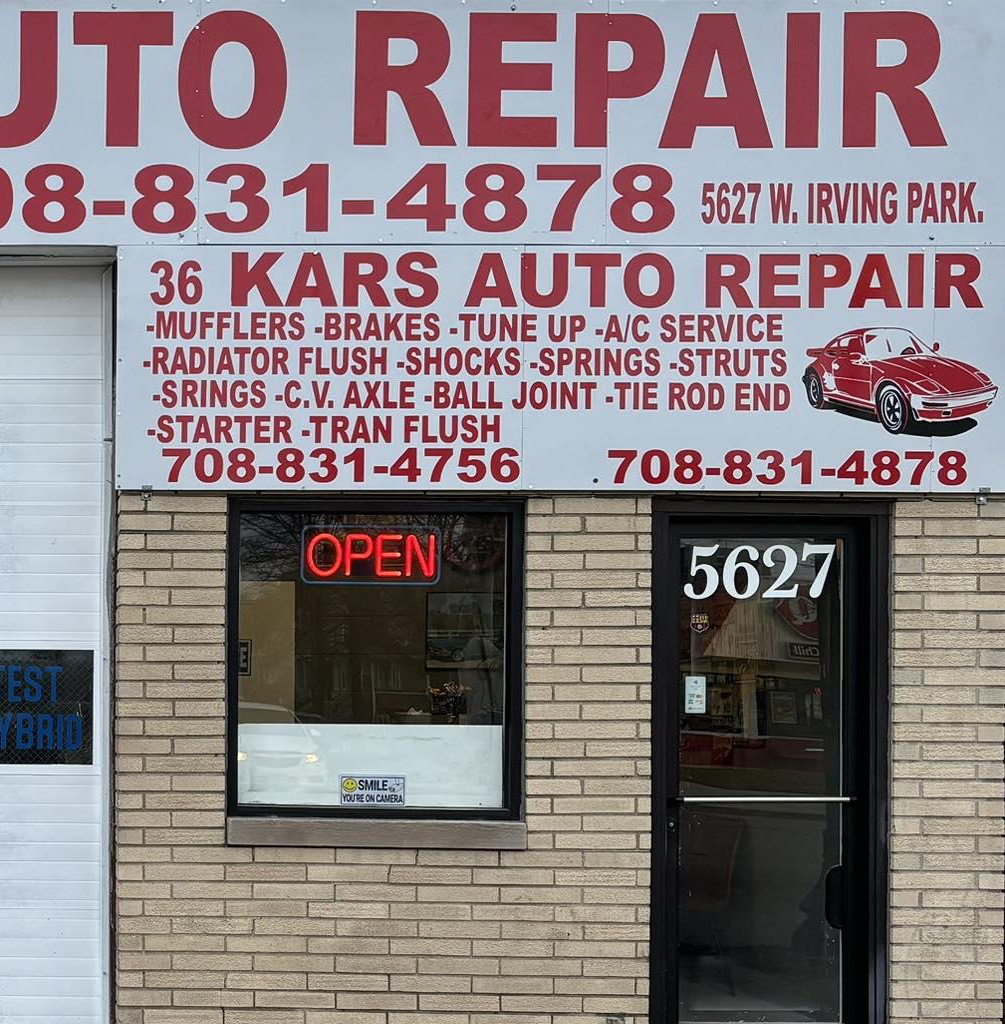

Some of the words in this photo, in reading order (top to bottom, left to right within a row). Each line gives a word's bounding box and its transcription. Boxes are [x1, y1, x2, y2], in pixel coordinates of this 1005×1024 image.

[354, 11, 948, 149] REPAIR
[701, 182, 761, 224] 5627
[770, 183, 798, 224] W.
[808, 182, 898, 224] IRVING
[907, 182, 984, 224] PARK.
[150, 260, 202, 304] 36
[231, 252, 439, 308] KARS
[466, 252, 675, 309] AUTO
[705, 253, 983, 309] REPAIR
[146, 311, 305, 341] -MUFFLERS
[314, 312, 440, 342] -BRAKES
[449, 313, 537, 342] -TUNE
[548, 315, 587, 342] UP
[595, 314, 650, 343] -A/C
[659, 314, 783, 343] SERVICE
[143, 346, 289, 376] -RADIATOR
[298, 347, 388, 376] FLUSH
[397, 347, 521, 377] -SHOCKS
[529, 347, 661, 377] -SPRINGS
[669, 348, 788, 378] -STRUTS
[152, 379, 267, 409] -SRINGS
[343, 381, 416, 410] AXLE
[423, 381, 503, 410] -BALL
[511, 381, 597, 411] JOINT
[605, 382, 659, 411] -TIE
[668, 382, 726, 412] ROD
[734, 383, 792, 412] END
[147, 415, 293, 444] -STARTER
[301, 415, 393, 444] -TRAN
[403, 415, 501, 444] FLUSH
[161, 447, 521, 485] 708-831-4756
[607, 449, 968, 487] 708-831-4878
[306, 533, 436, 577] OPEN
[683, 543, 836, 600] 5627
[358, 779, 388, 791] SMILE
[365, 794, 375, 803] ON
[375, 794, 403, 803] CAMERA
